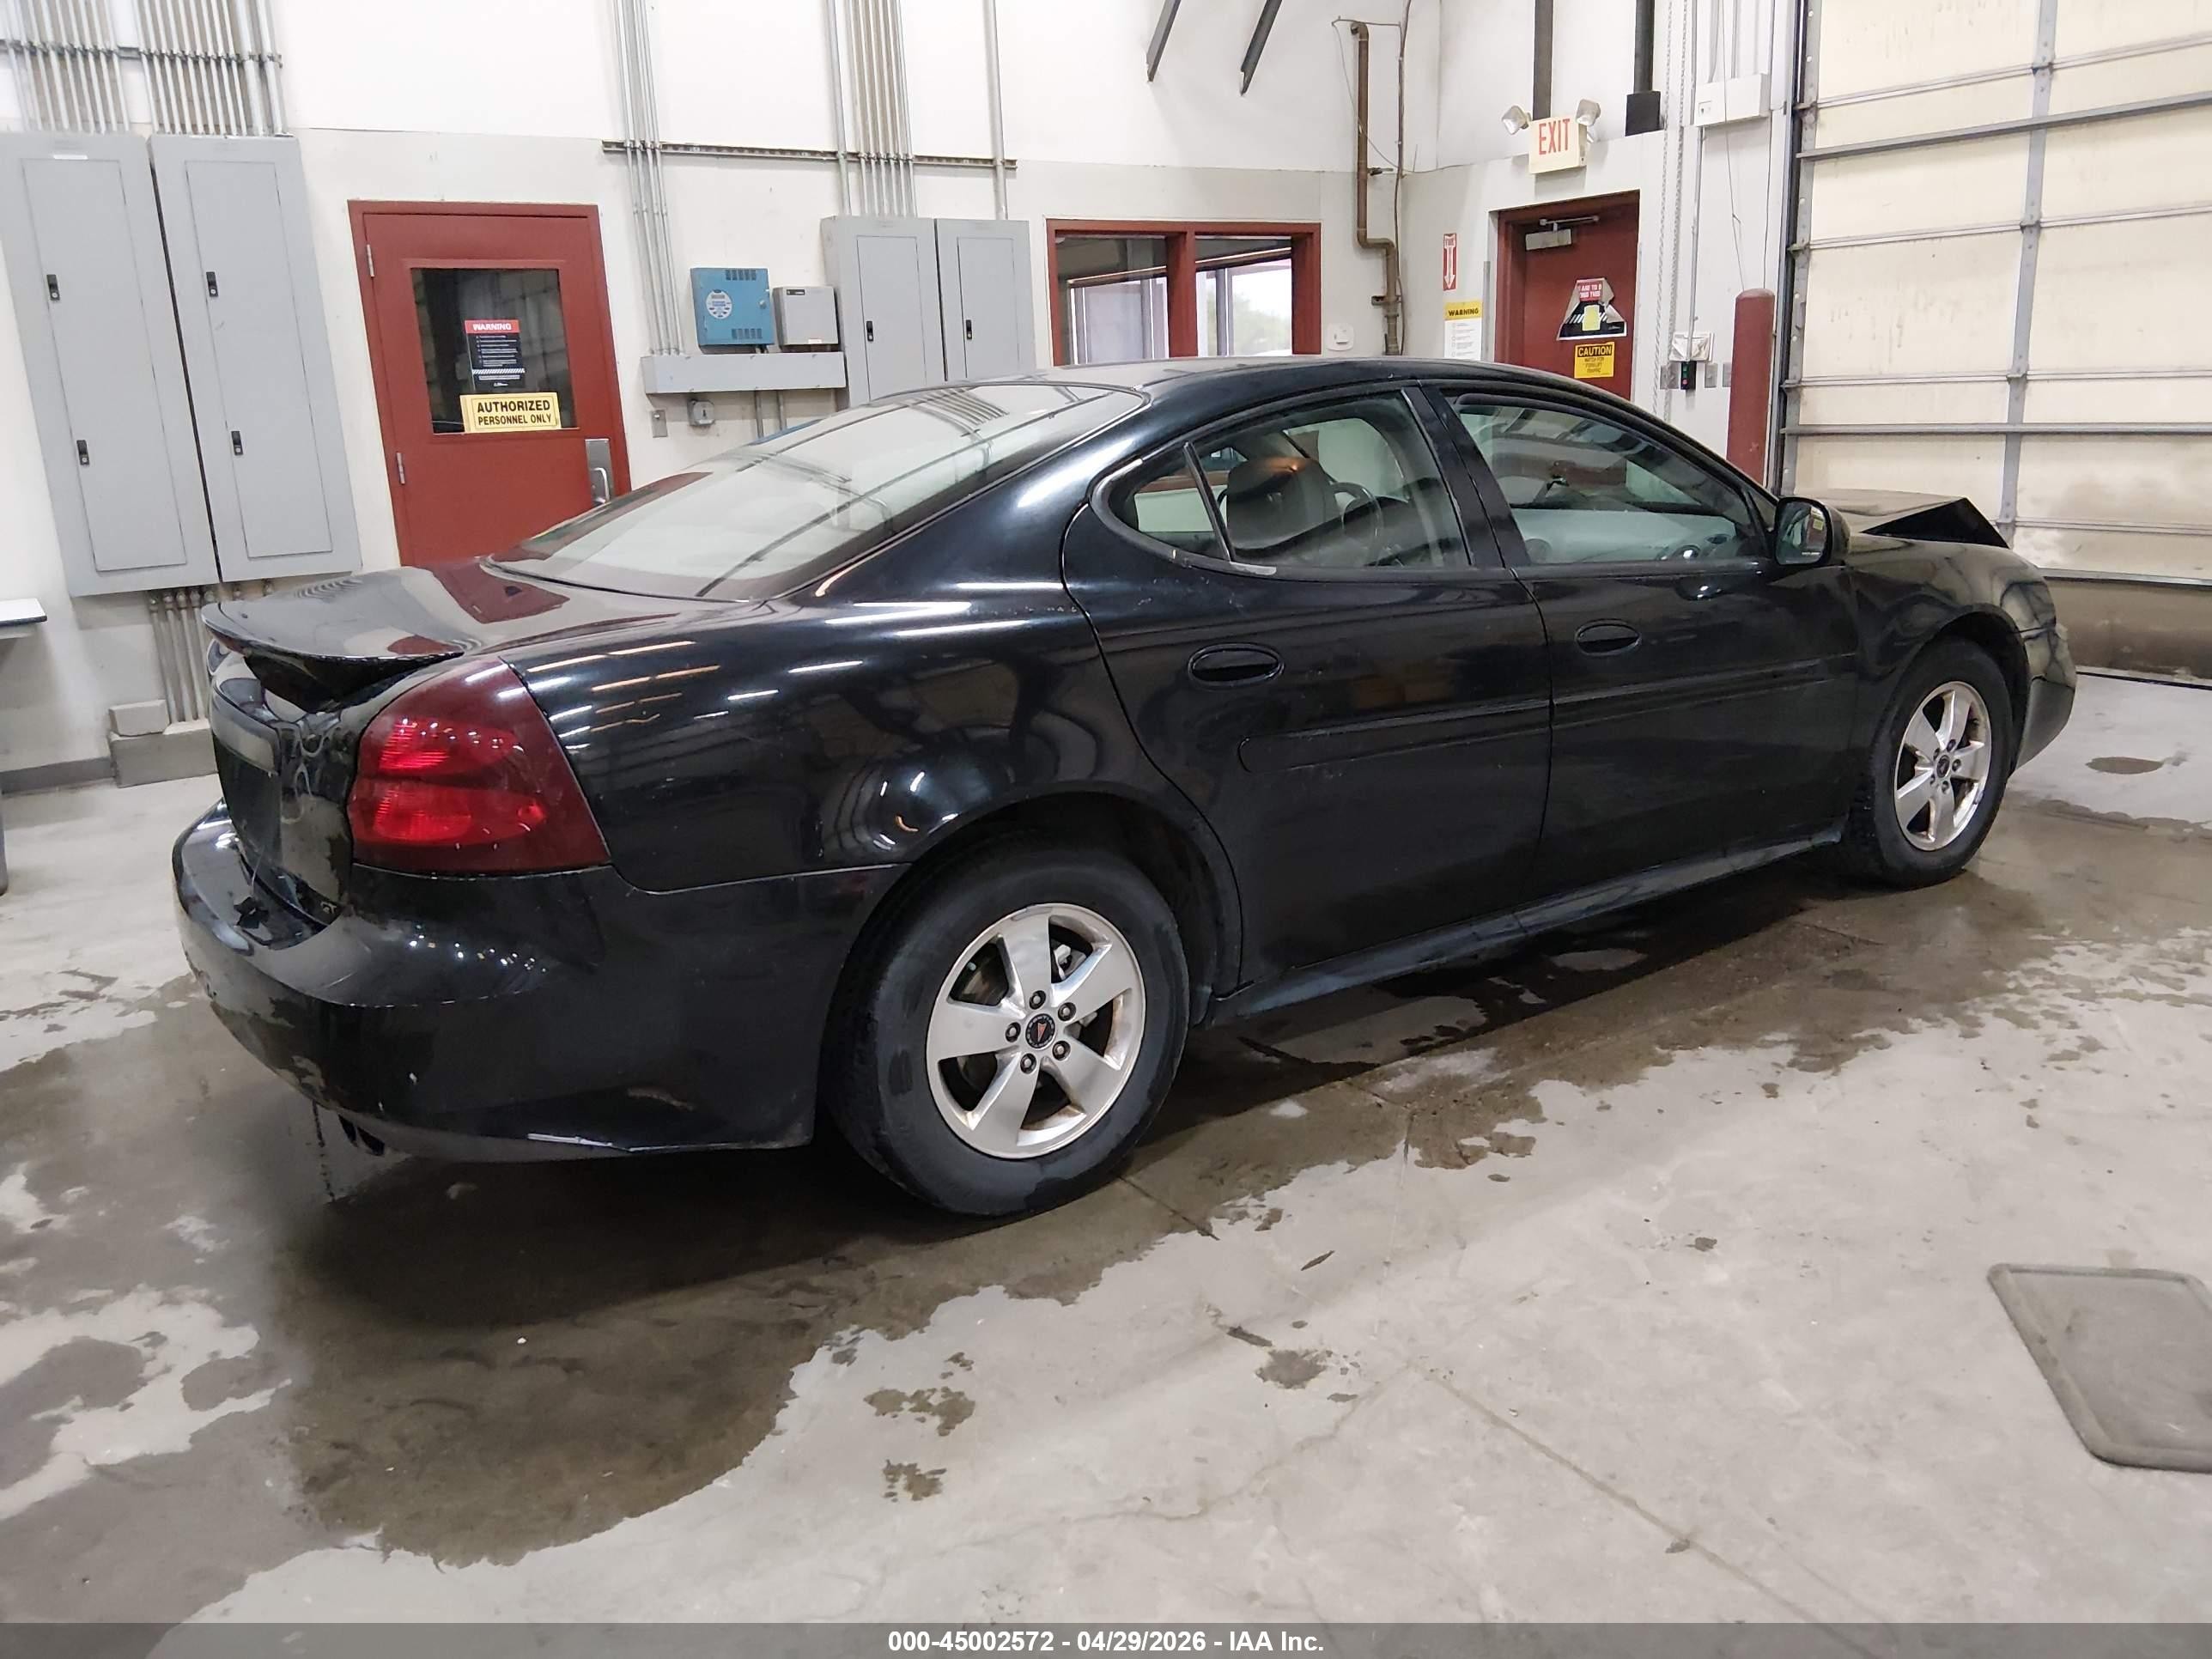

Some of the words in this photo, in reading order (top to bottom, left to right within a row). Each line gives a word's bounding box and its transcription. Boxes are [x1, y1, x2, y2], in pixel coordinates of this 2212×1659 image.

[1538, 118, 1571, 155] EXIT
[1448, 307, 1479, 316] WARNING
[472, 323, 512, 331] WARNING
[1578, 345, 1612, 356] CAUTION
[477, 399, 550, 413] AUTHORIZED
[477, 415, 528, 426] PERSONNEL
[530, 413, 551, 423] ONLY
